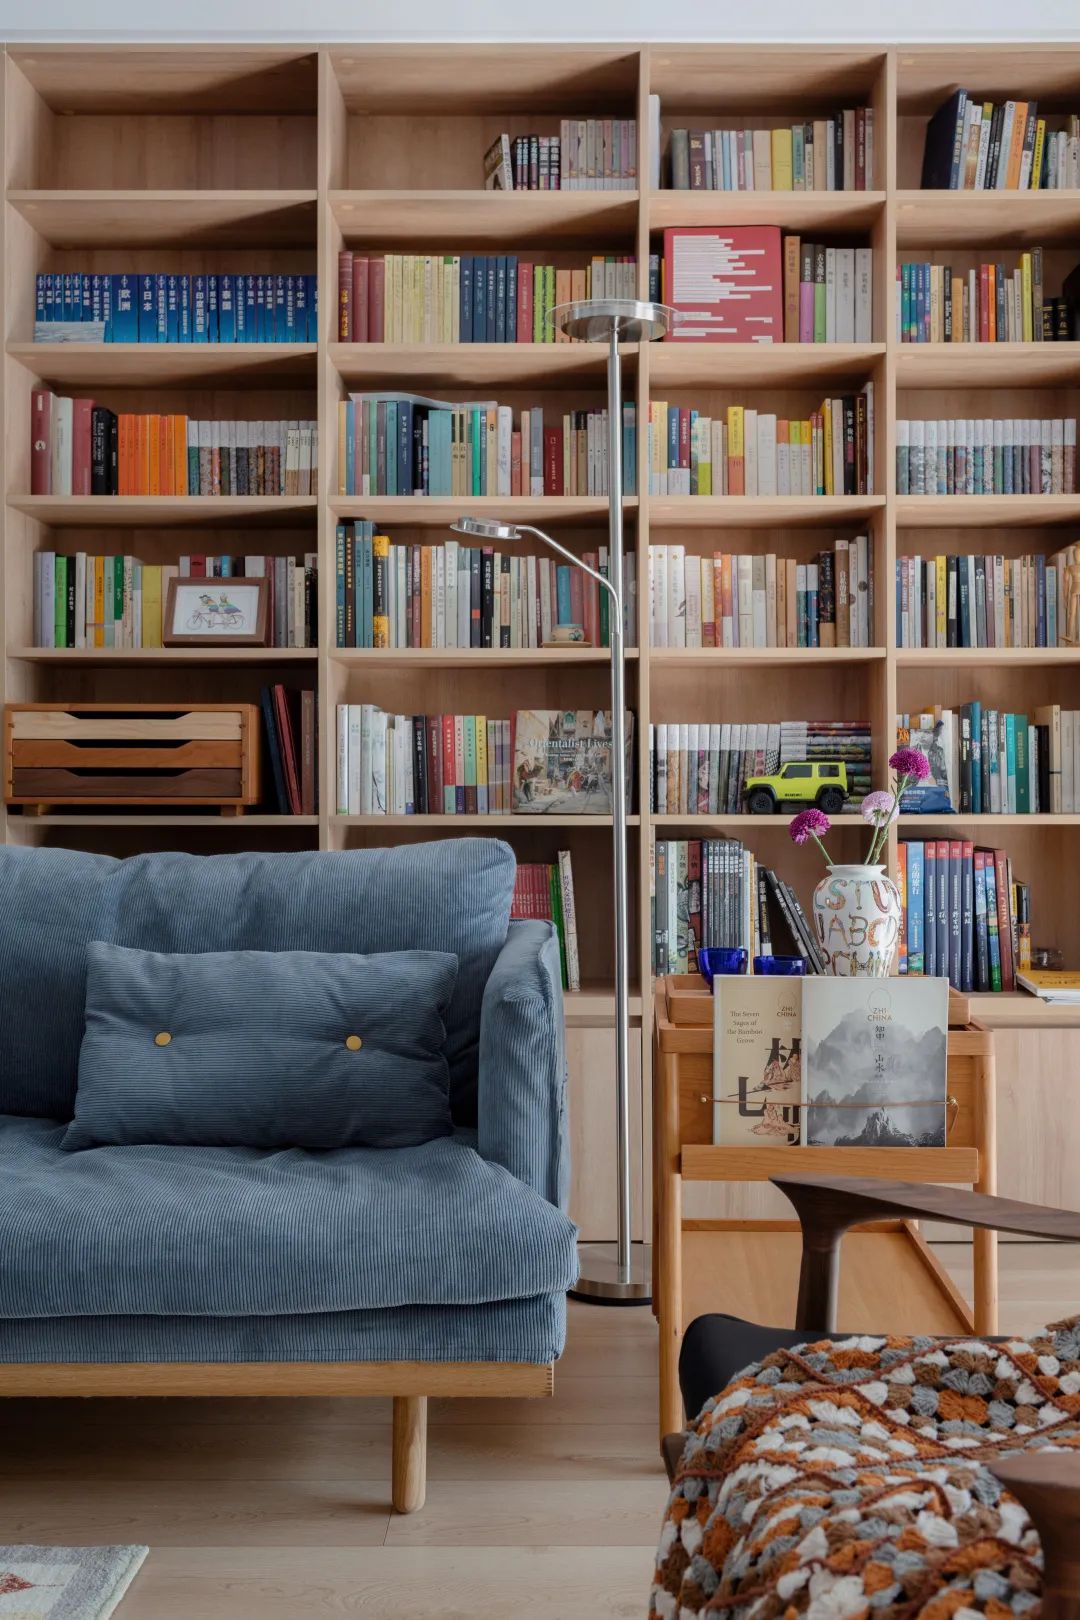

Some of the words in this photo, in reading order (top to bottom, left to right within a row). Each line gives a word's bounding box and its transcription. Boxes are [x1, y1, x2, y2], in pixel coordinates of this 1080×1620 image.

[143, 291, 153, 312] 日本
[529, 738, 583, 749] Orientalist
[587, 738, 613, 748] Lives
[1000, 896, 1009, 930] CHINA
[732, 1020, 749, 1028] Sages
[867, 1014, 893, 1022] CHINA
[875, 1054, 886, 1073] 山水
